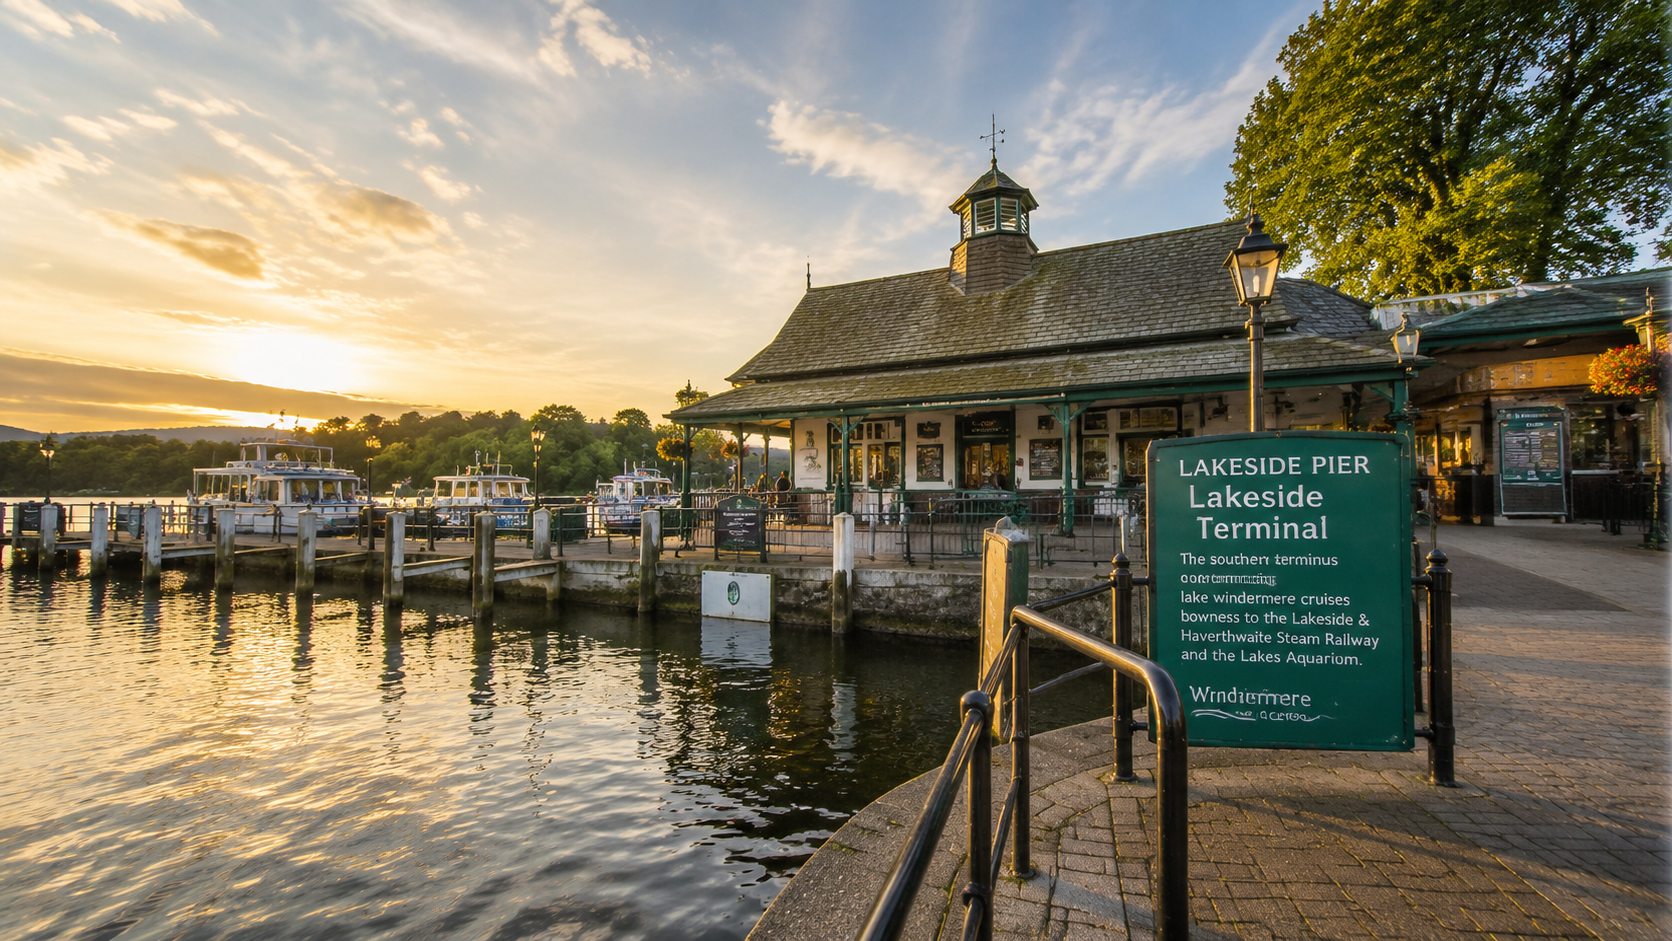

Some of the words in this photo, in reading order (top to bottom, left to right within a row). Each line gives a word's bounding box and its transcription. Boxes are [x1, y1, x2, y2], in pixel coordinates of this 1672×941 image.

[1179, 456, 1302, 477] LAKESIDE
[1311, 455, 1371, 475] PIER
[1189, 484, 1324, 509] Lakeside
[1196, 515, 1328, 540] Terminal
[1180, 552, 1206, 566] The
[1274, 553, 1339, 567] terminus
[1180, 590, 1209, 604] lake
[1213, 590, 1296, 605] windermere
[1300, 592, 1351, 606] cruises
[1180, 609, 1240, 624] bowness
[1244, 611, 1259, 624] to
[1263, 611, 1288, 625] the
[1292, 611, 1354, 626] Lakeside
[1358, 613, 1370, 627] &
[1181, 628, 1272, 644] Haverthwaite
[1276, 631, 1320, 645] Steam
[1181, 648, 1207, 661] and
[1212, 648, 1236, 662] the
[1241, 649, 1281, 663] Lakes
